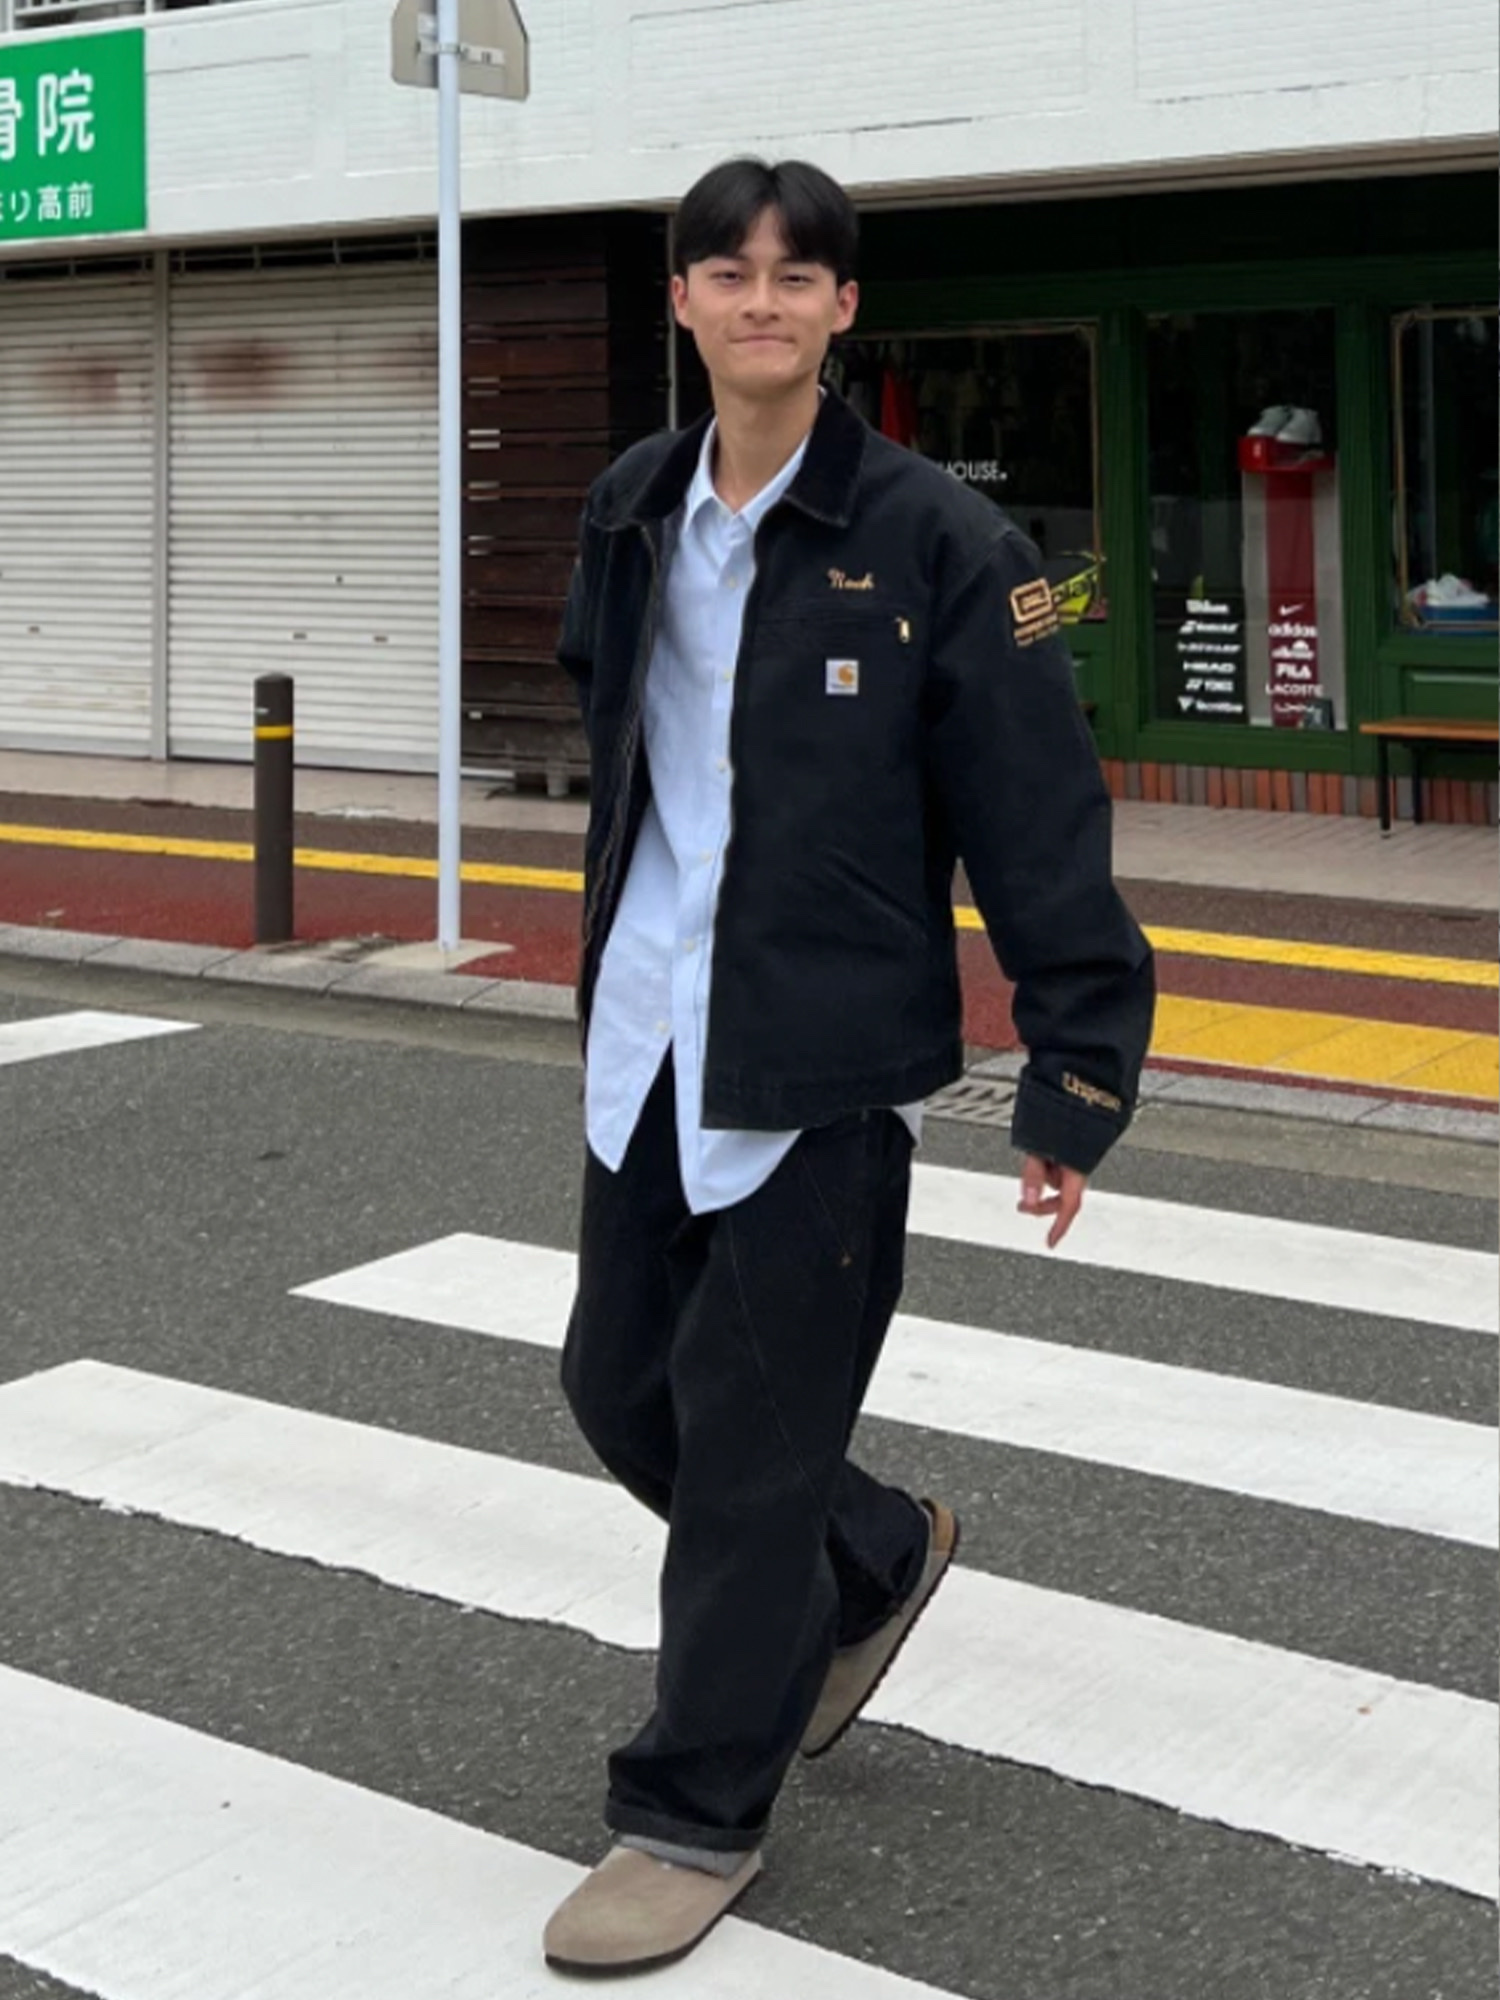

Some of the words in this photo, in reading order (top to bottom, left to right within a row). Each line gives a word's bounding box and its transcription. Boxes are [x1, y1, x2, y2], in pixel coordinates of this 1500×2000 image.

[0, 181, 94, 222] り高前
[1268, 622, 1318, 637] adidas
[1183, 661, 1236, 674] HEAD
[1276, 663, 1312, 679] FILA
[1265, 682, 1325, 697] LACOSTE
